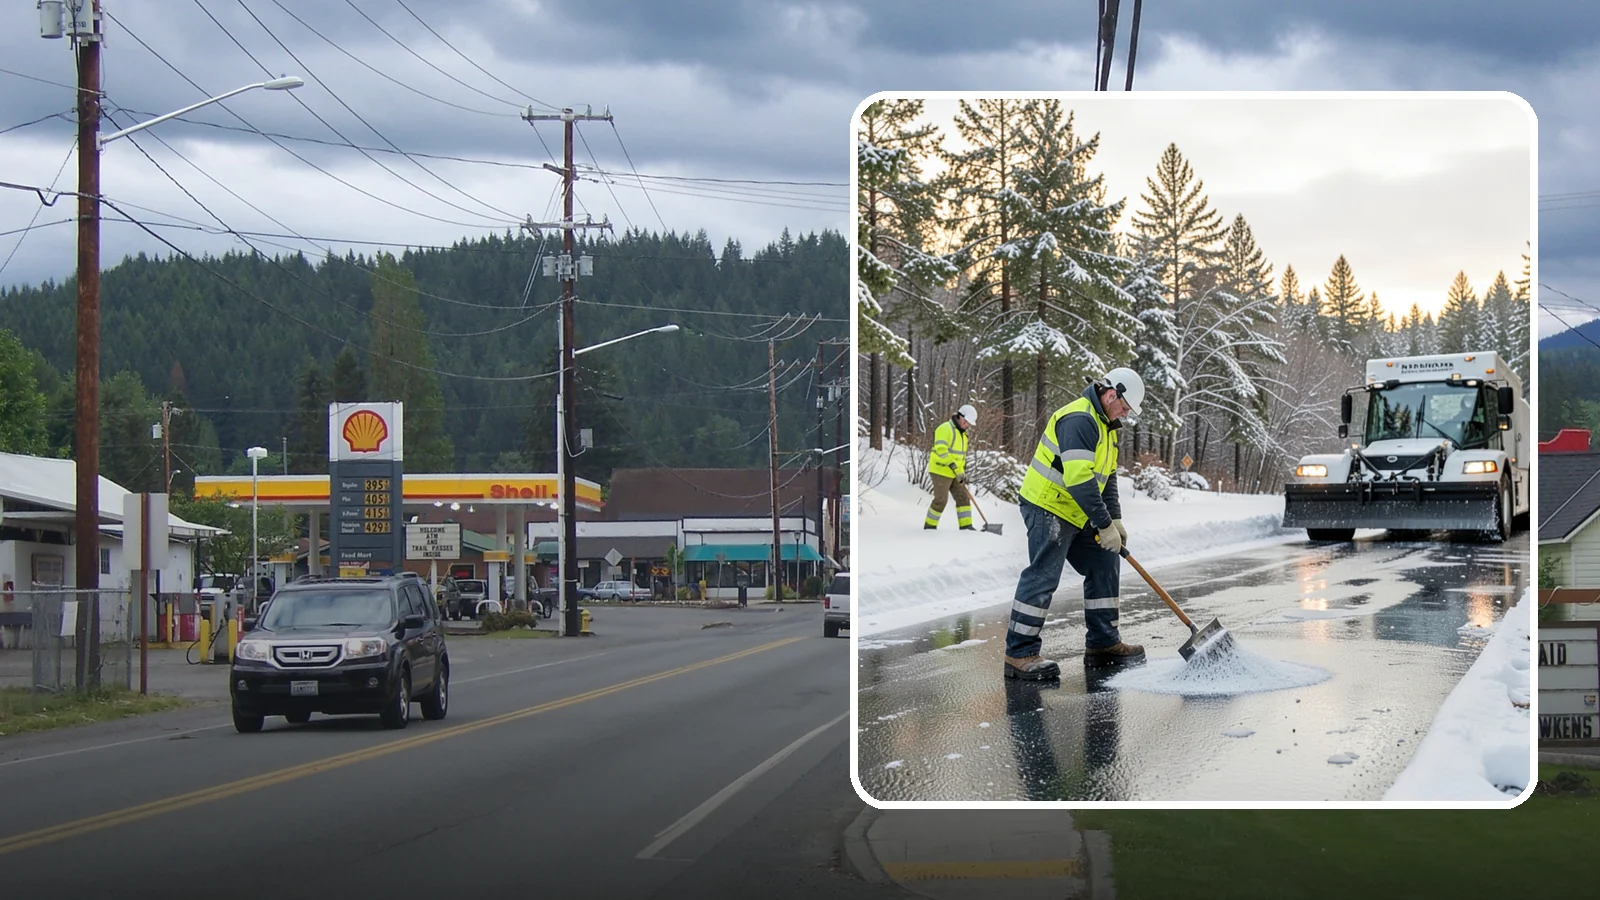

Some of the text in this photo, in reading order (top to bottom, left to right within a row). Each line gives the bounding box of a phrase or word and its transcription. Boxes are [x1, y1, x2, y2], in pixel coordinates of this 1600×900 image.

[366, 480, 384, 490] 395
[490, 484, 547, 499] Shell
[366, 494, 384, 504] 405
[366, 508, 384, 518] 415
[366, 522, 384, 532] 429
